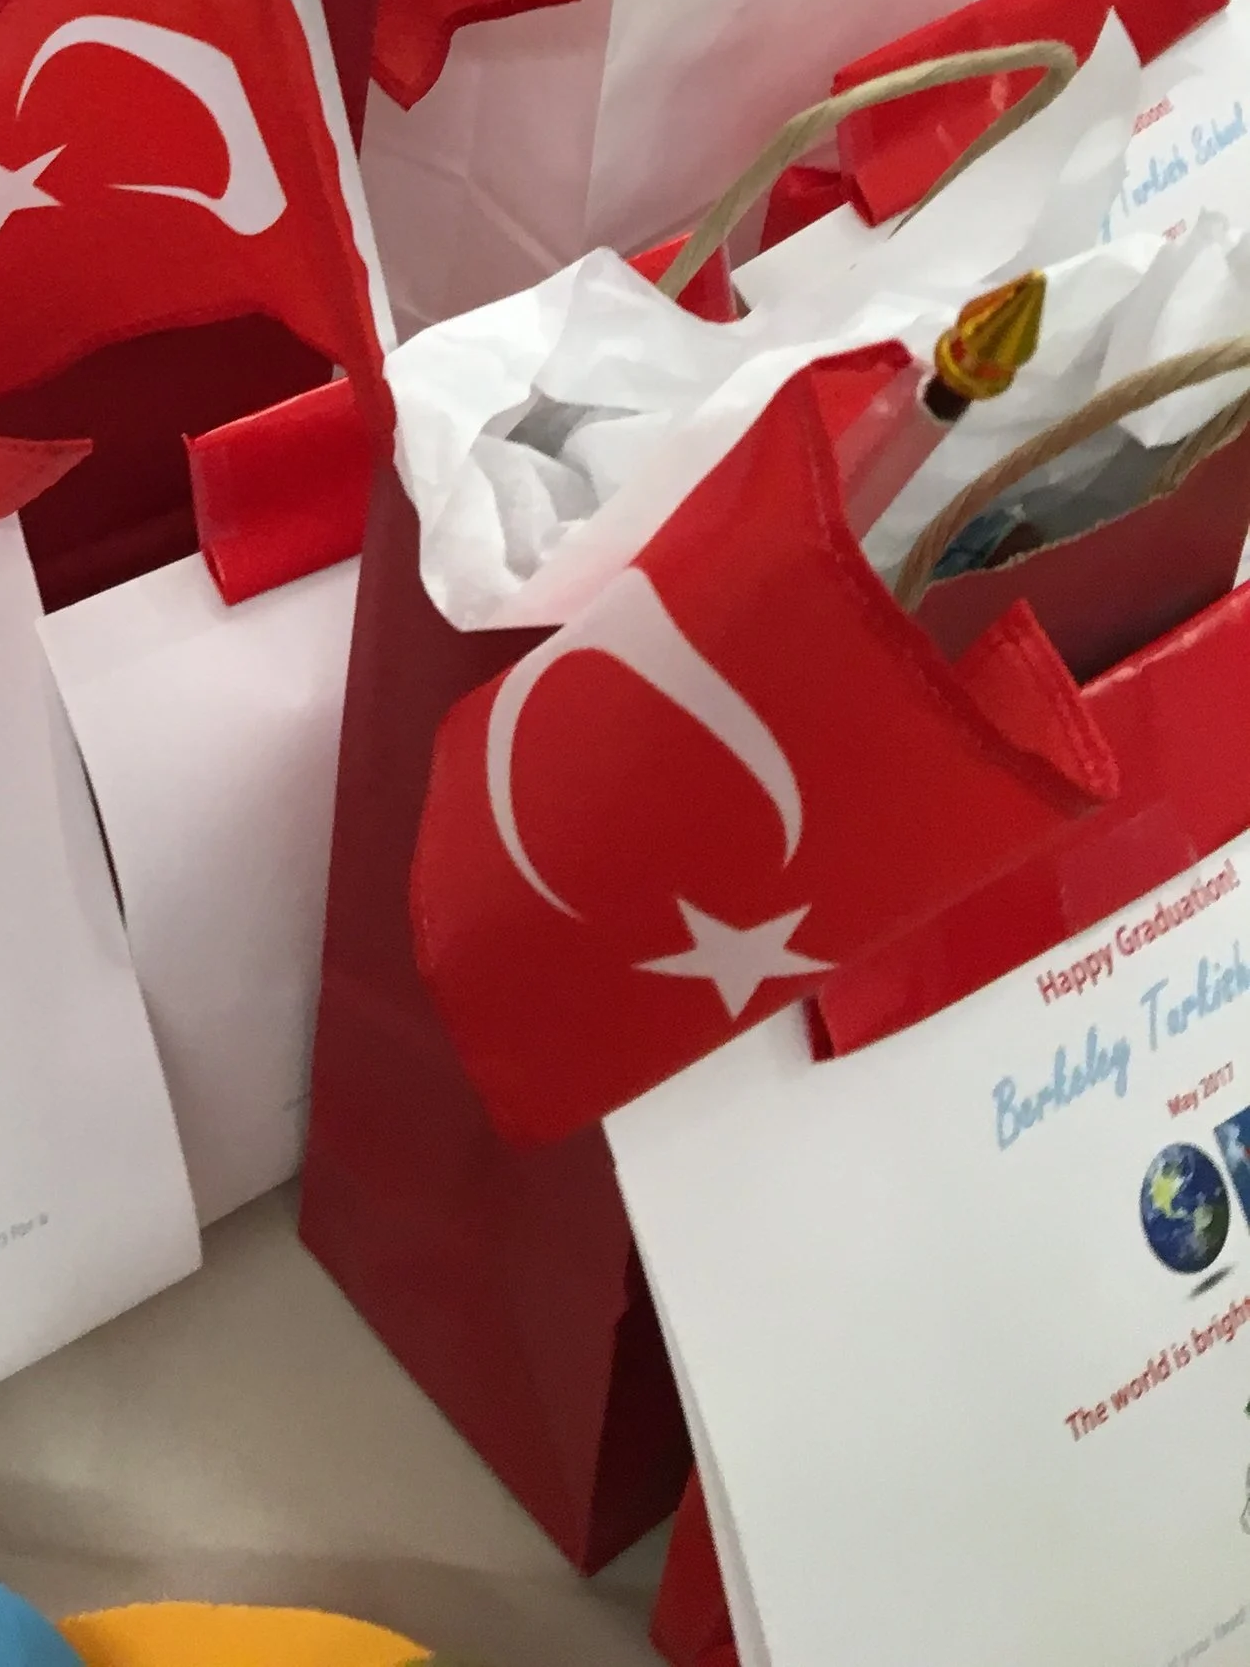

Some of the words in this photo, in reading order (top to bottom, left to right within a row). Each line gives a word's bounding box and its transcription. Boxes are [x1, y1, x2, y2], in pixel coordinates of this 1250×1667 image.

[1036, 942, 1113, 1006] Happy
[1115, 857, 1241, 956] Graduation!
[992, 1023, 1131, 1151] Berkeley
[1140, 939, 1250, 1052] Turkish
[1167, 1089, 1199, 1118] May
[1198, 1061, 1234, 1099] 2017
[1065, 1401, 1109, 1442] The
[1110, 1349, 1171, 1412] world
[1170, 1342, 1192, 1370] is
